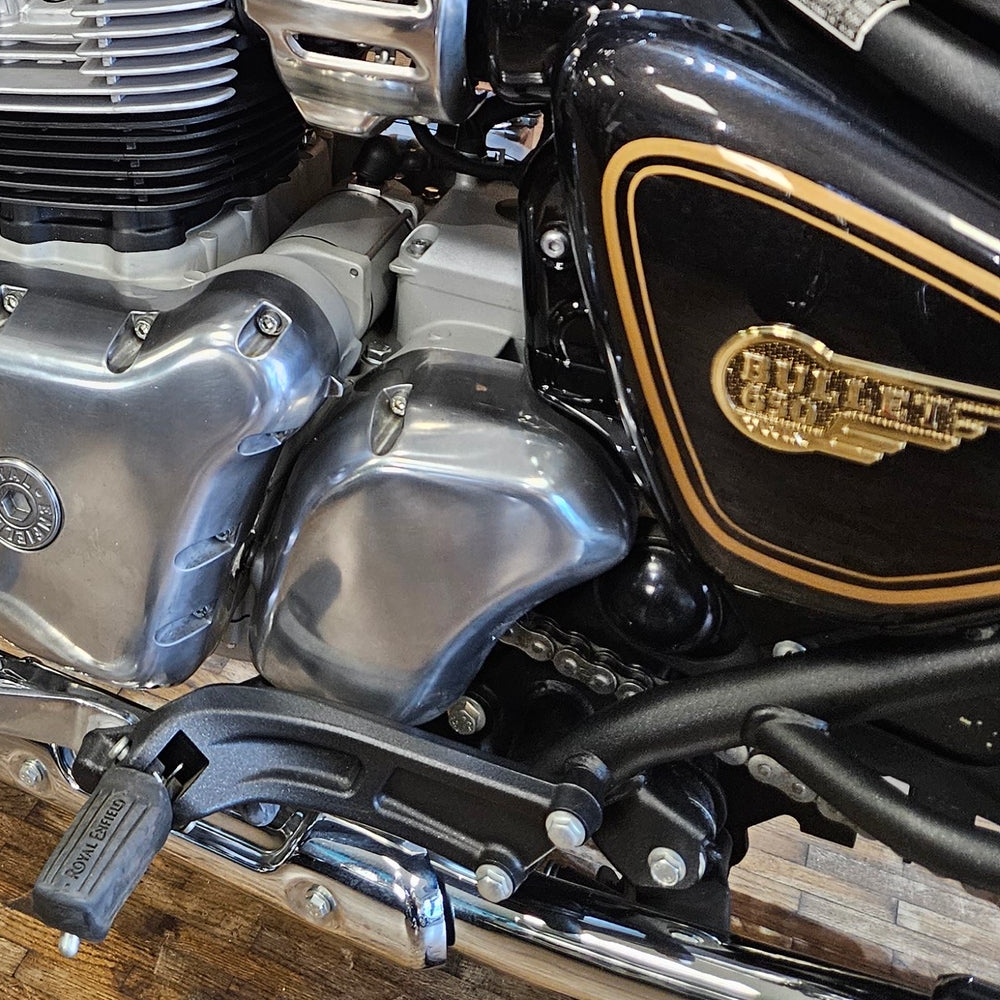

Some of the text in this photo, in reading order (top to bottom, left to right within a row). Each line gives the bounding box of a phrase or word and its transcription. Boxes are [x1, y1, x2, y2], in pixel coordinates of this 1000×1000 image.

[742, 351, 953, 430] BULLET
[64, 799, 126, 880] ROYAL ENFIELD
